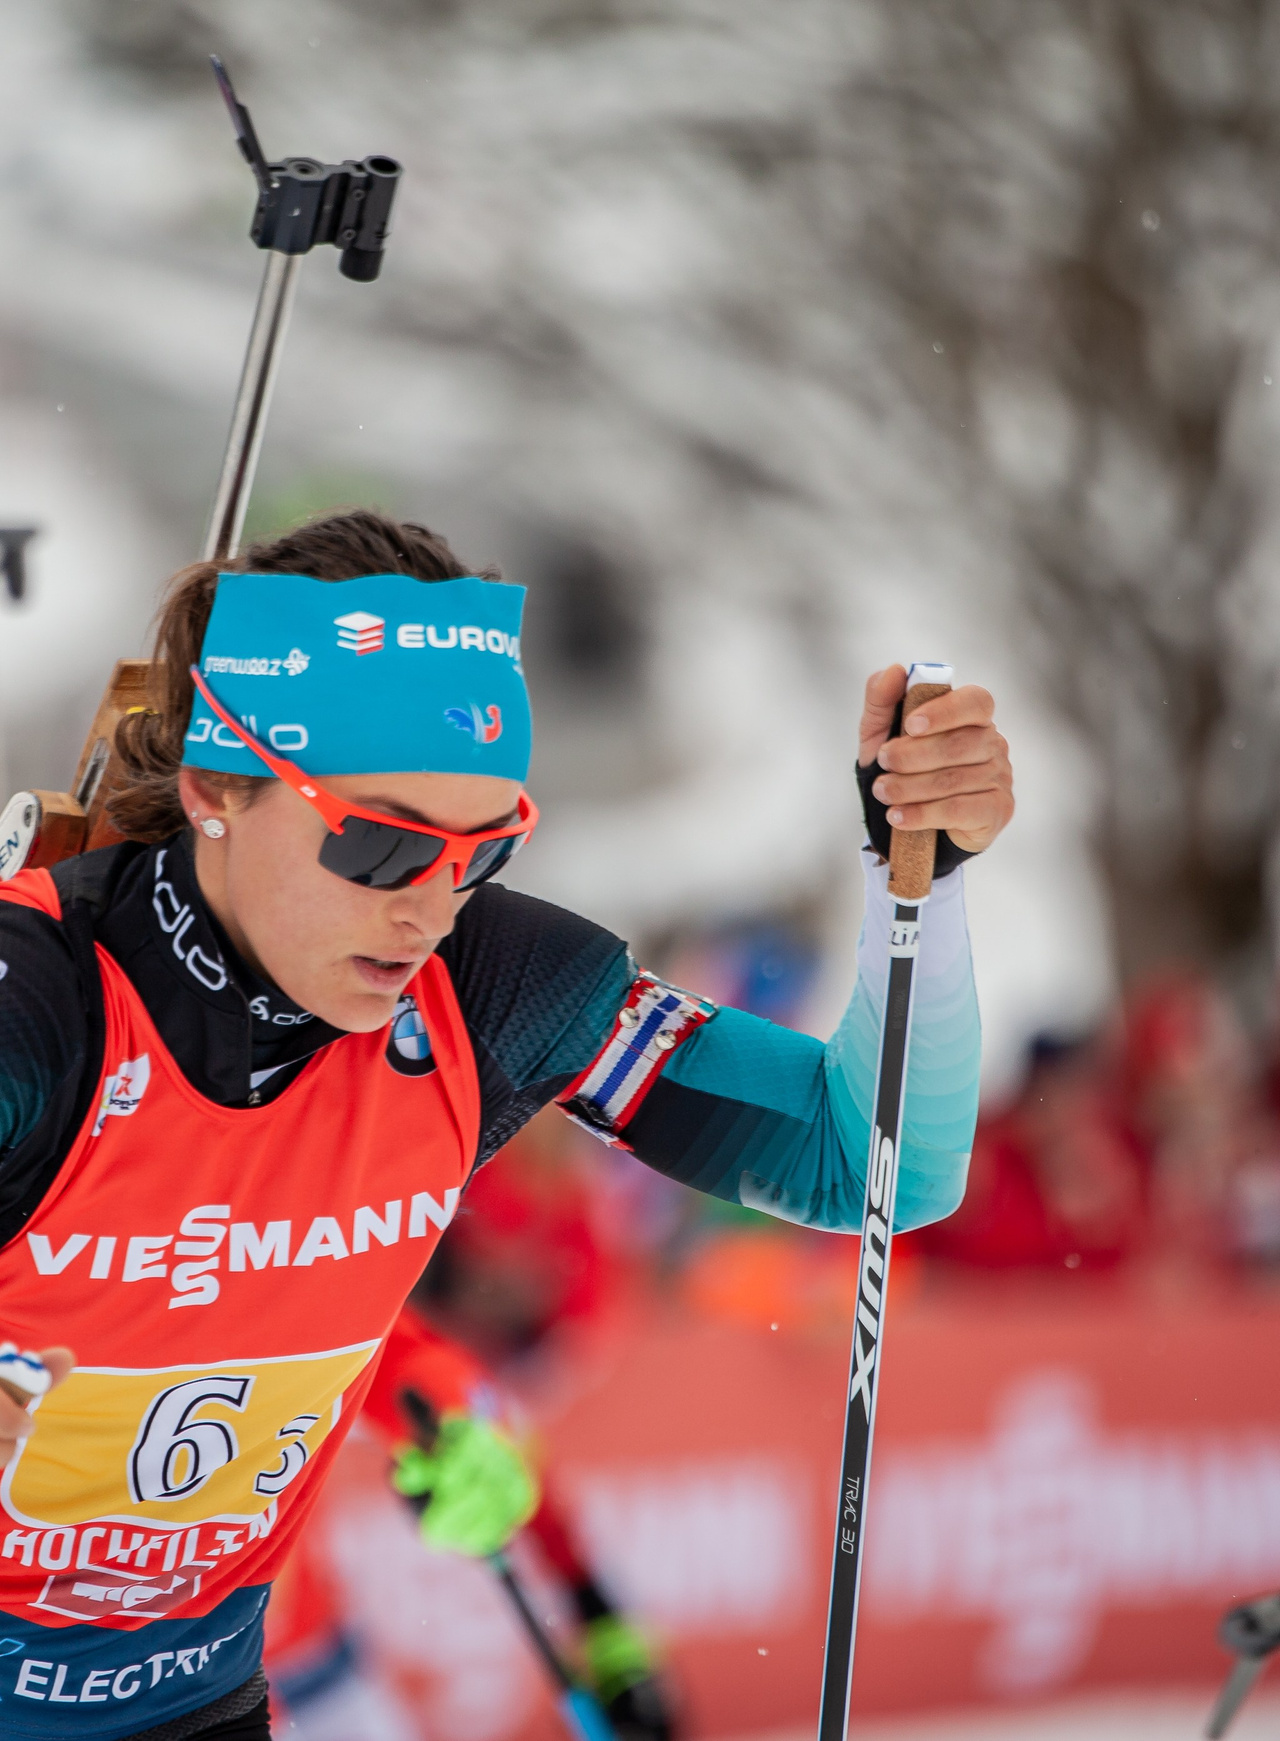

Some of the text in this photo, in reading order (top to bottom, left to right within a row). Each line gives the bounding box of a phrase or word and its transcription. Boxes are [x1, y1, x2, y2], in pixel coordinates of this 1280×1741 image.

[27, 1187, 460, 1310] VIESSMANN
[127, 1375, 256, 1504] 6
[841, 1476, 860, 1555] TRIAC 30
